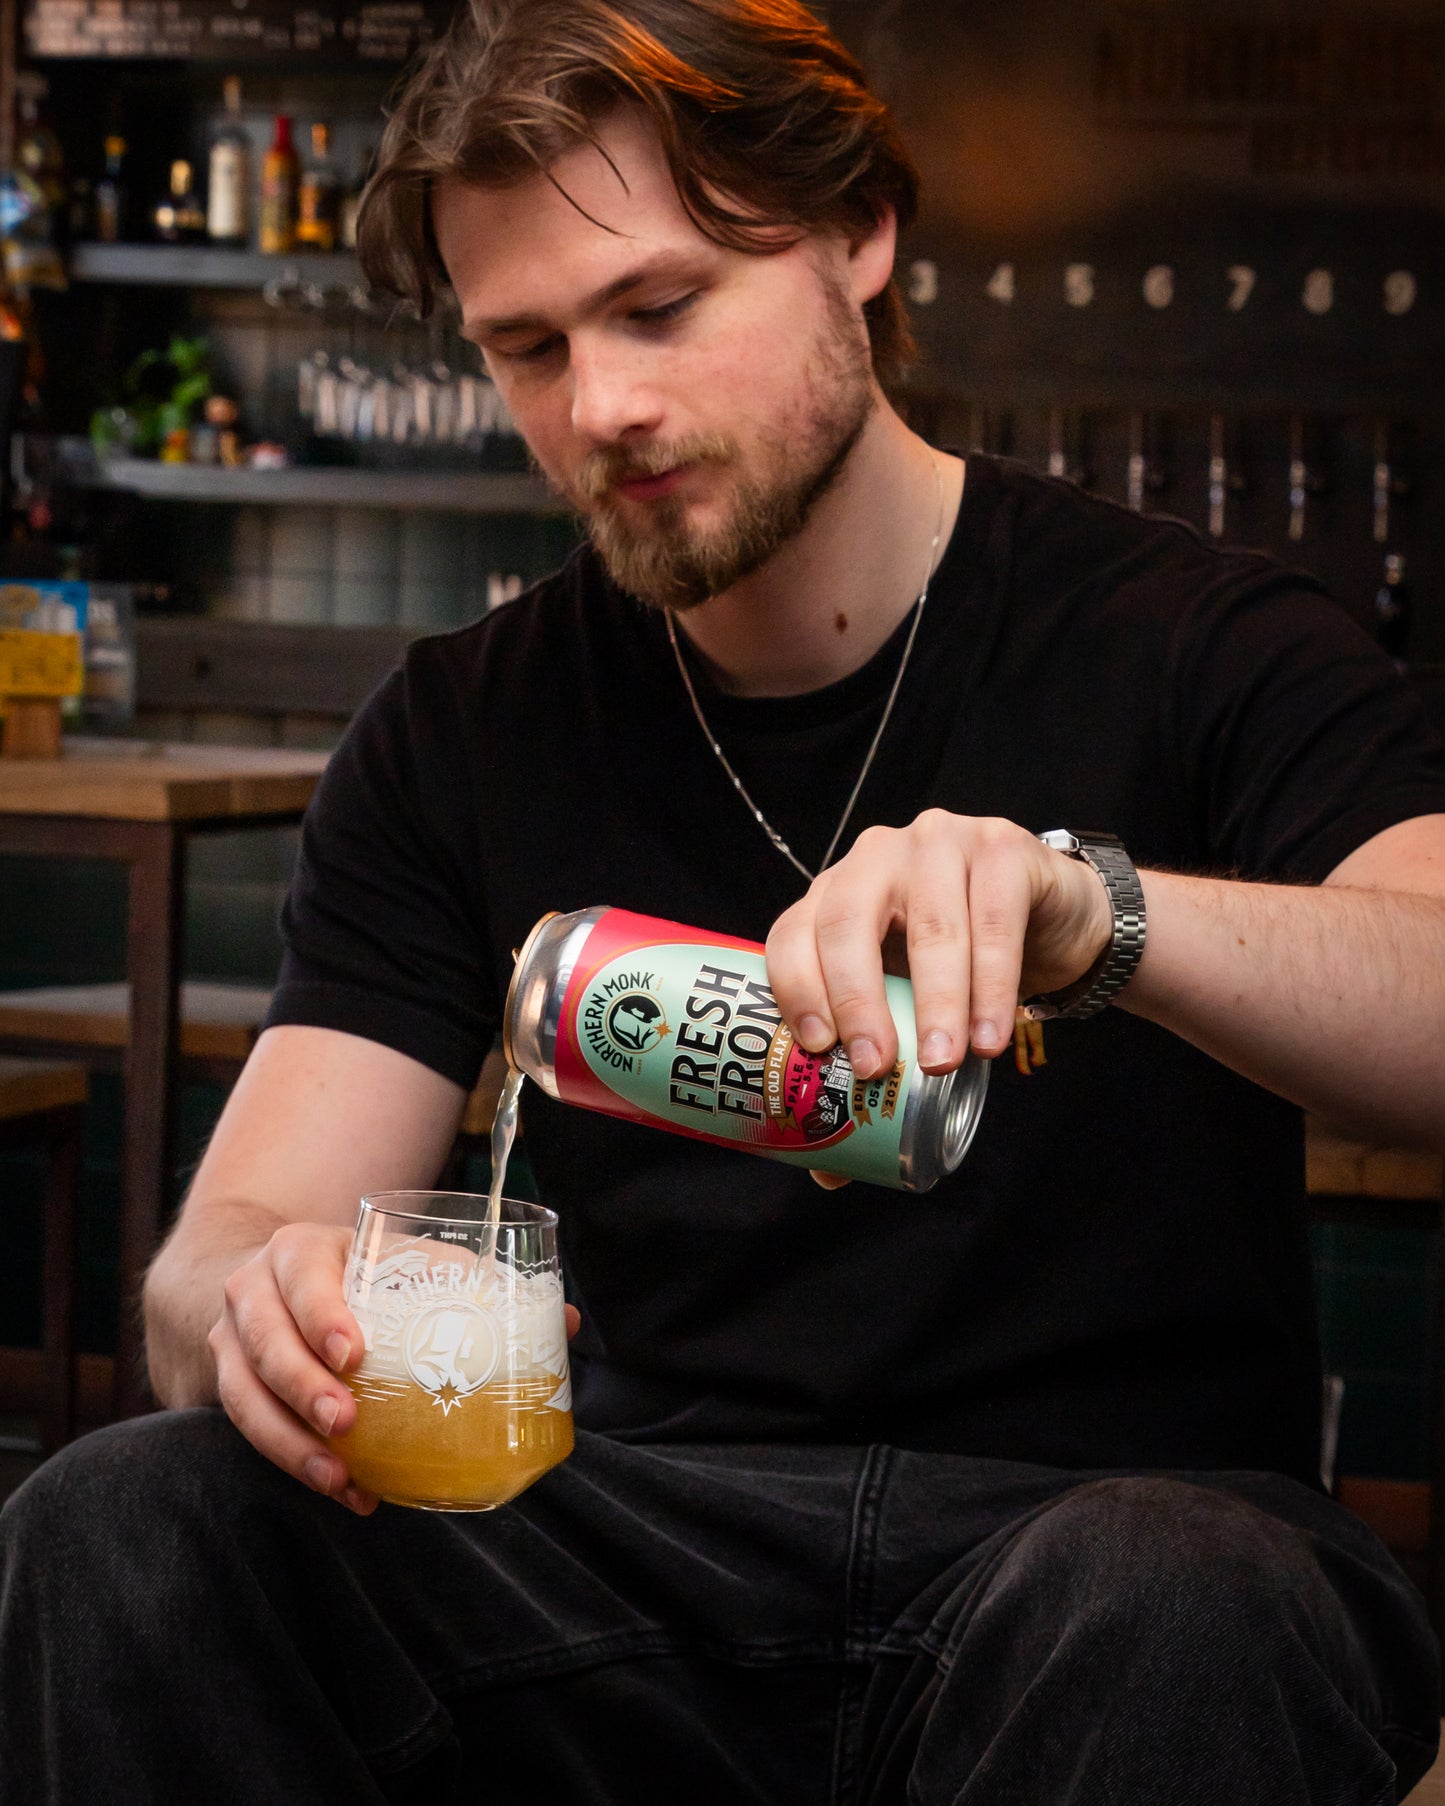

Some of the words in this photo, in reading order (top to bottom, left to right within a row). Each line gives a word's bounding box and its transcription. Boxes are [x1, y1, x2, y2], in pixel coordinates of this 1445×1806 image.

[909, 260, 938, 305] 3
[987, 262, 1015, 305] 4
[1227, 264, 1257, 312] 7
[602, 971, 654, 998] MONK
[584, 993, 633, 1073] NORTHERN
[669, 963, 747, 1116] FRESH
[717, 980, 782, 1125] FROM
[770, 1037, 789, 1070] FLAX
[768, 1073, 780, 1094] OLD
[787, 1063, 804, 1104] PALE
[854, 1078, 866, 1112] EDIT
[885, 1071, 901, 1108] 2026
[767, 1096, 782, 1115] THE
